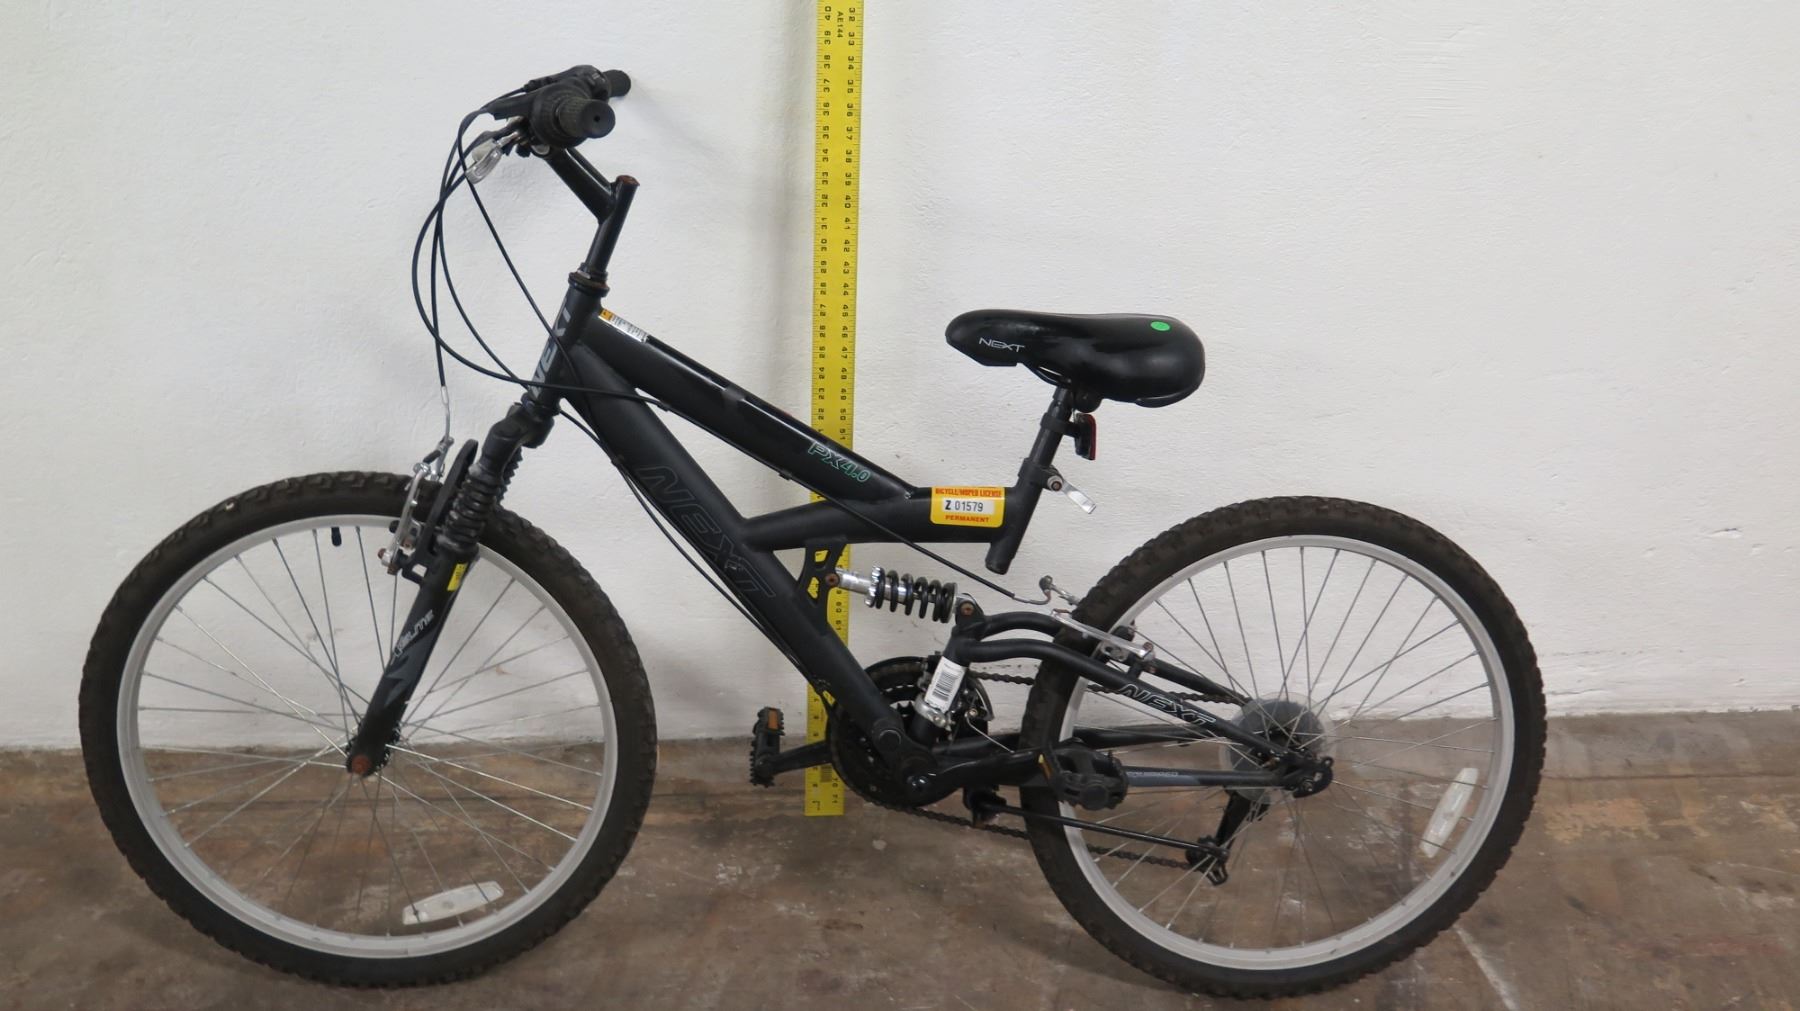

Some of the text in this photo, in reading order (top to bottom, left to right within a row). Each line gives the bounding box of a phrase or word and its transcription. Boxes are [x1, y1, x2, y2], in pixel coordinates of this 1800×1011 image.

[818, 6, 831, 420] 22 23 24 25 26 27 28 29 30 31 32 33 34 35 36 37 38 39 40
[840, 8, 855, 440] 32 33 34 35 36 37 38 39 40 41 42 43 44 45 46 47 48 49 50 51
[979, 337, 1024, 352] NEXT
[808, 441, 871, 483] PX4.0
[944, 514, 989, 523] PERMANENT
[945, 500, 983, 512] Z 01579
[636, 466, 776, 597] NEXT
[1119, 684, 1216, 726] NEXT
